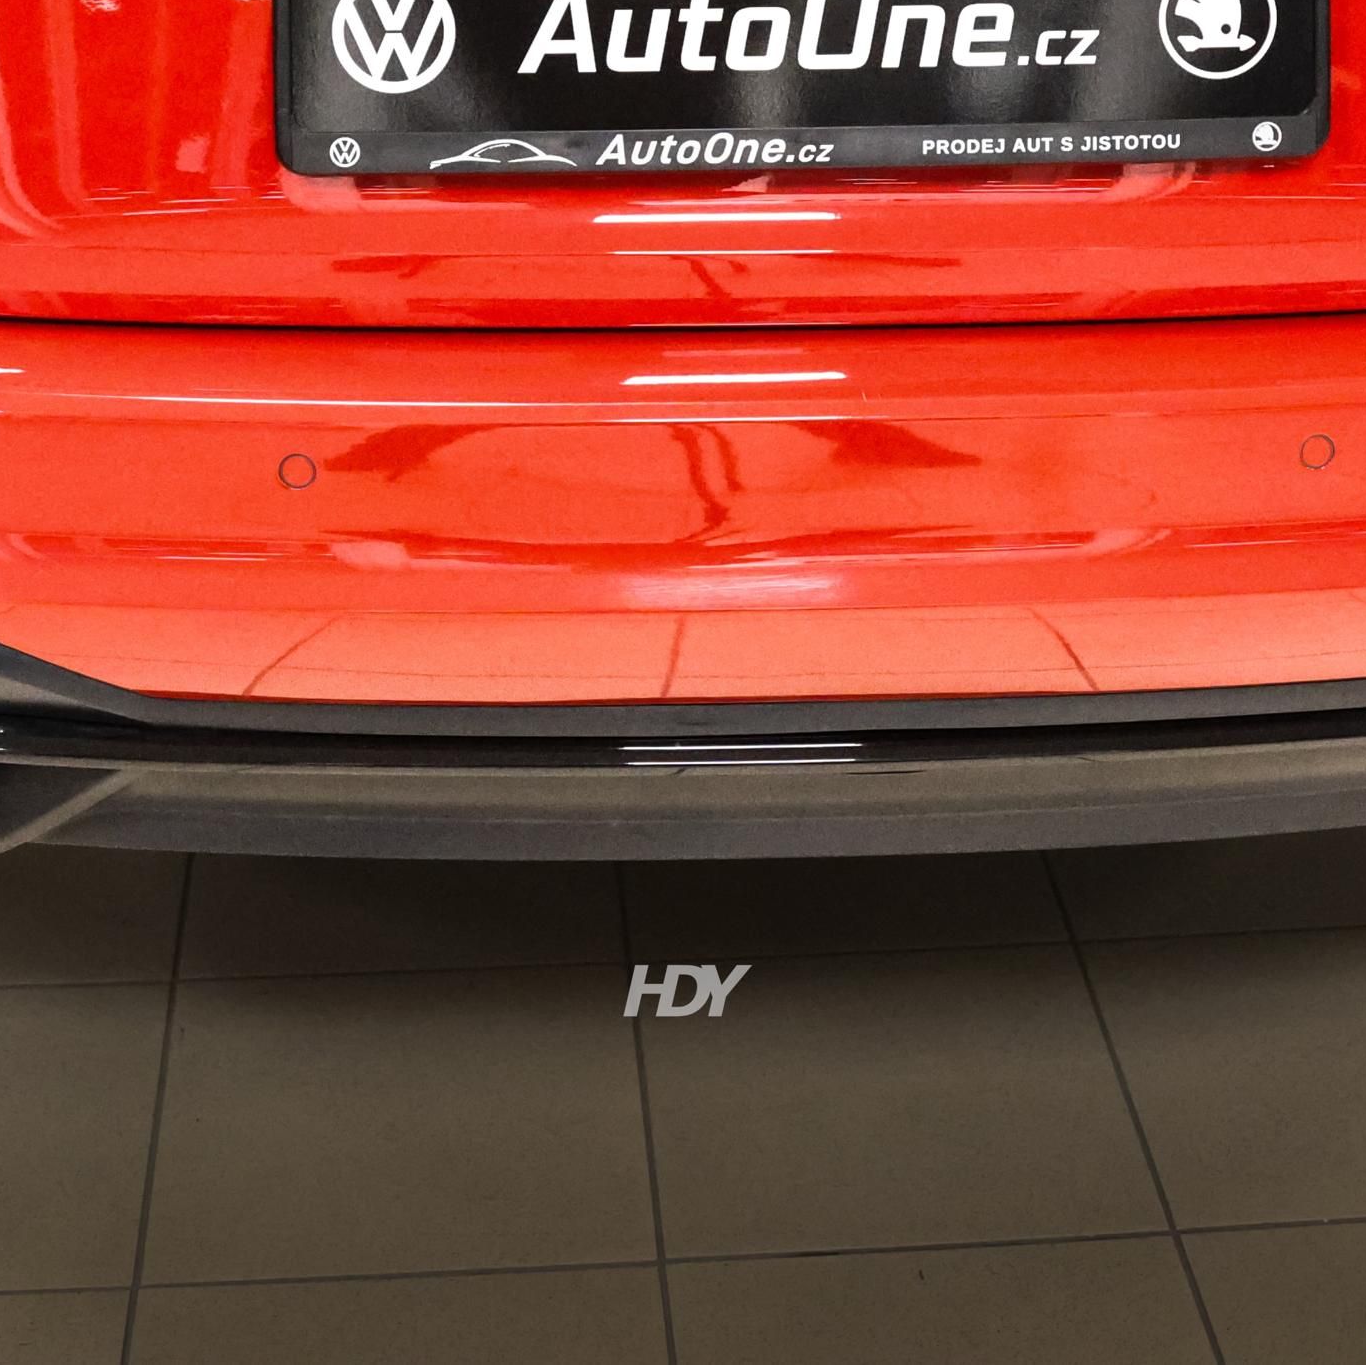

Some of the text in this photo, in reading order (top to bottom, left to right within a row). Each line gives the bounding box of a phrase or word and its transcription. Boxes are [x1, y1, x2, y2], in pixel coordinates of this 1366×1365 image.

[595, 132, 834, 165] AutoOne.cz
[921, 134, 1182, 155] PRODEJ AUT S JISTOTOU
